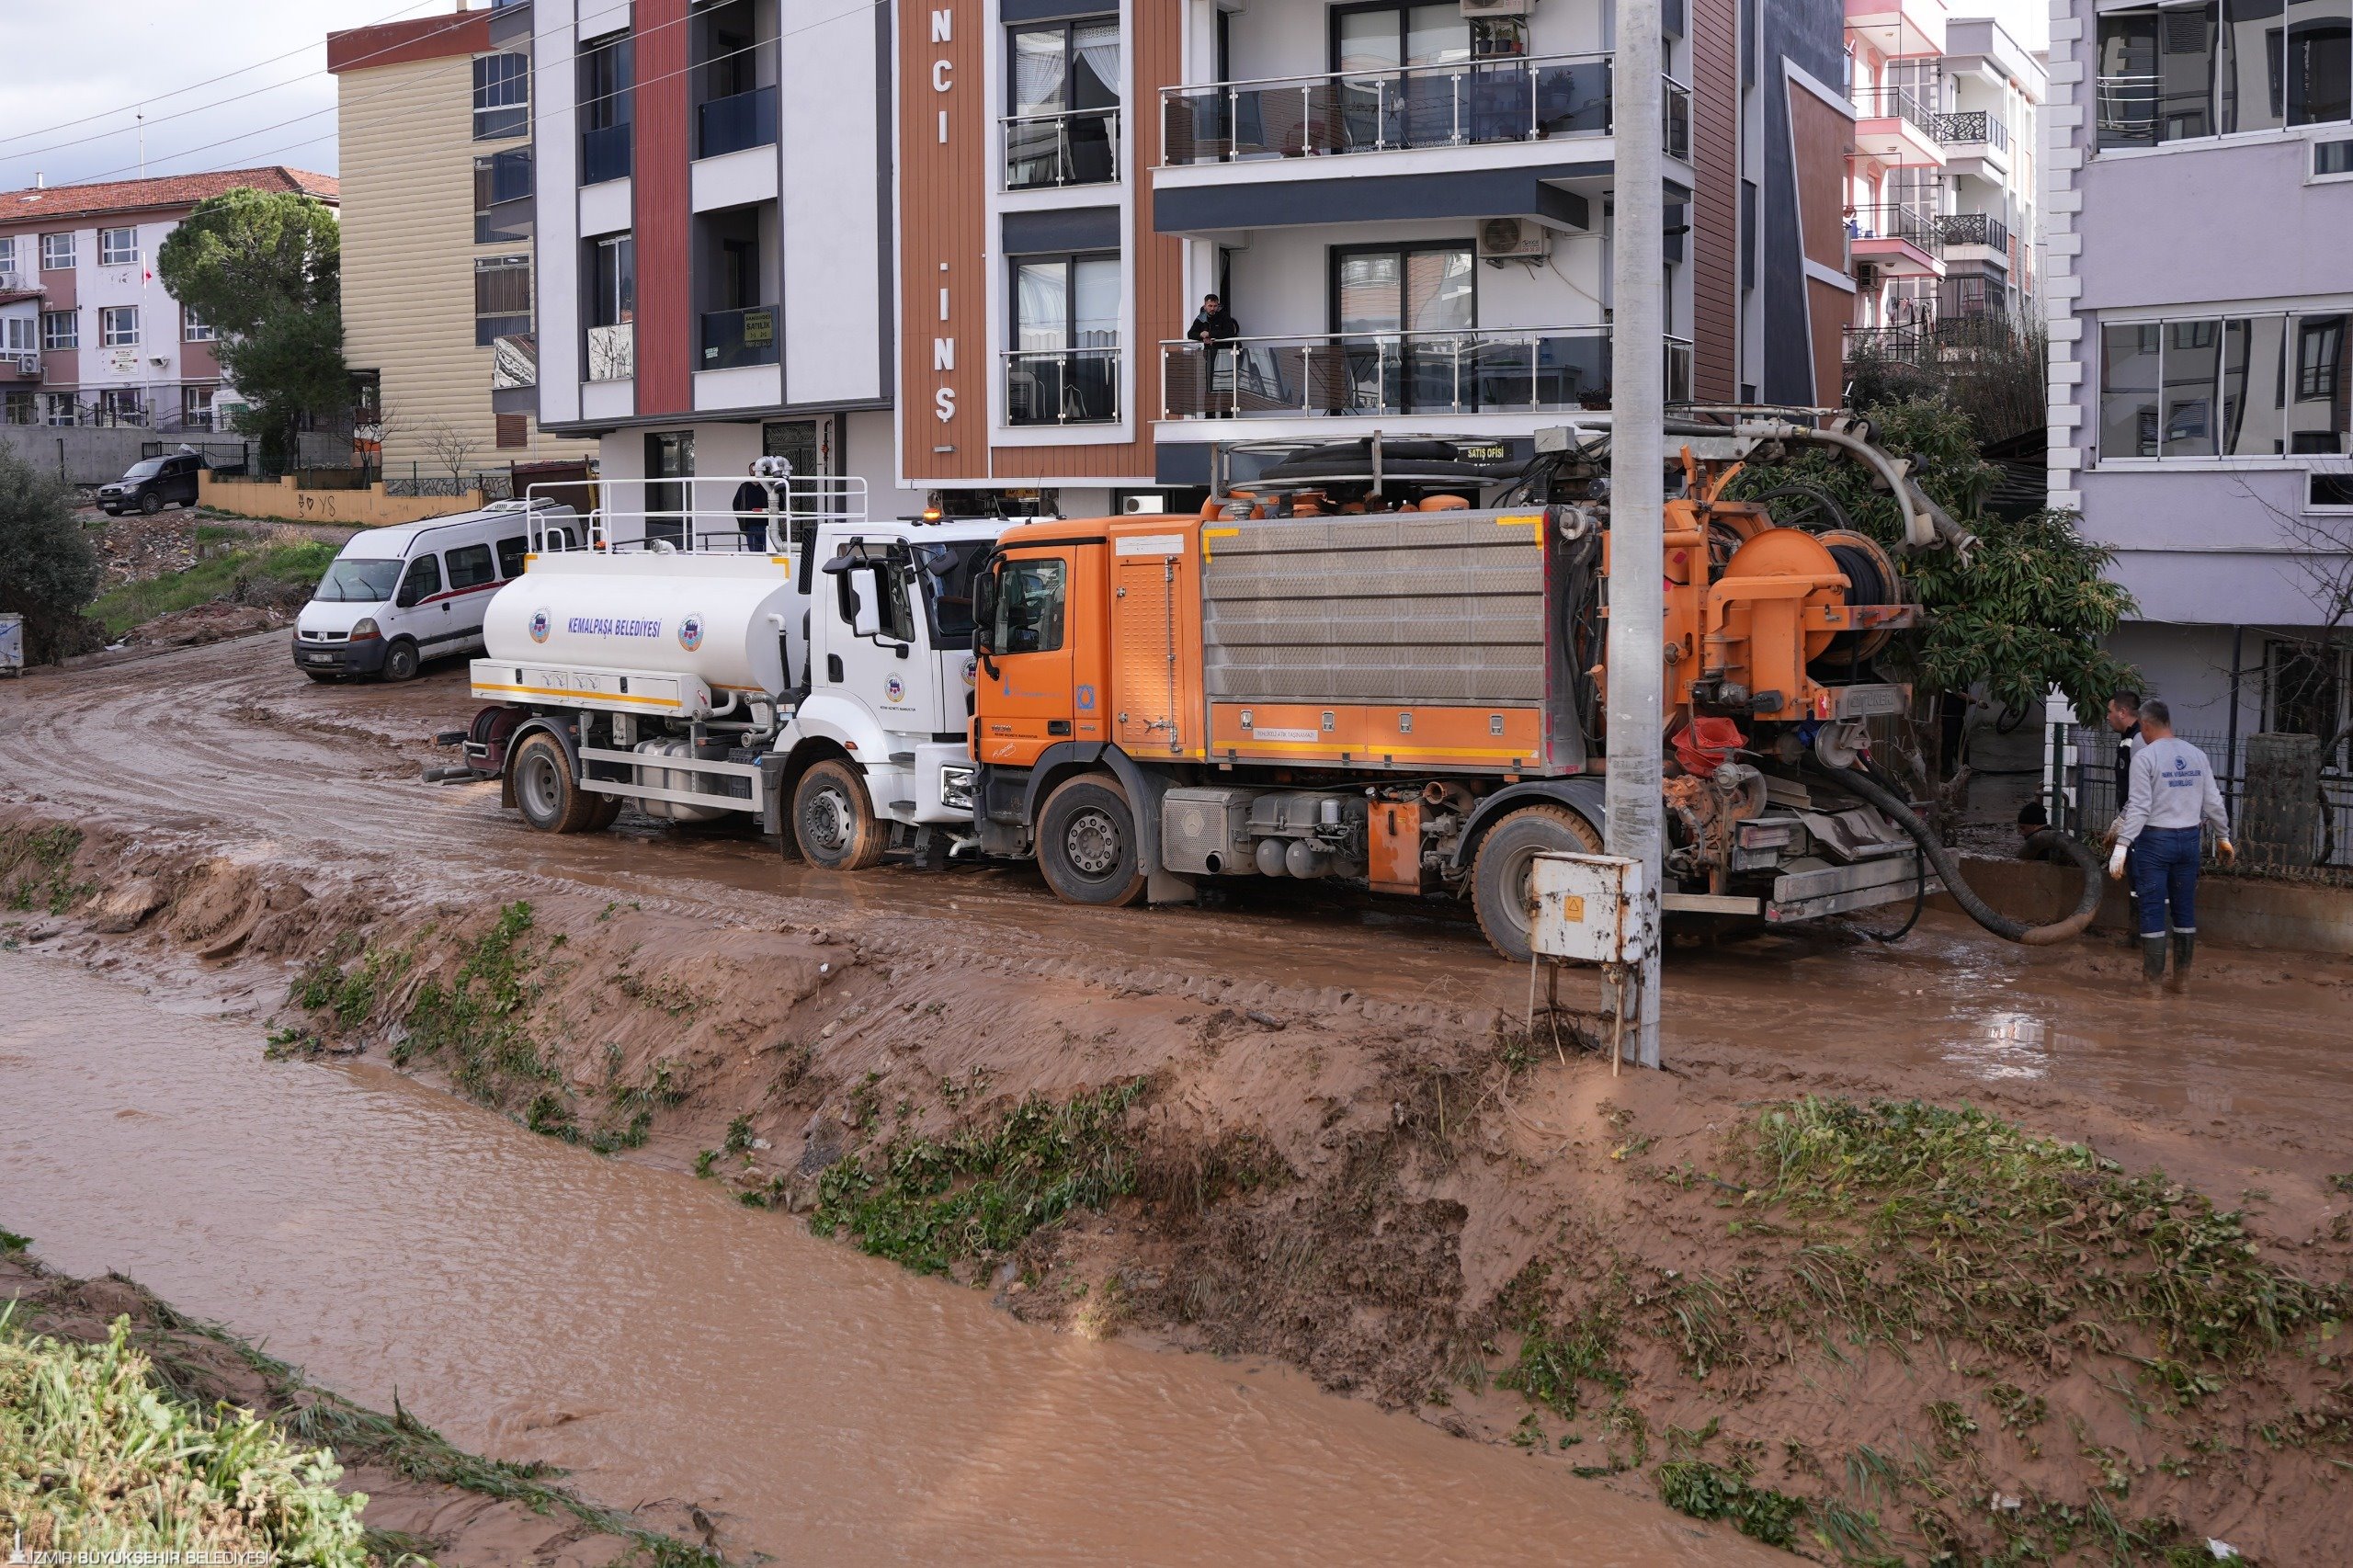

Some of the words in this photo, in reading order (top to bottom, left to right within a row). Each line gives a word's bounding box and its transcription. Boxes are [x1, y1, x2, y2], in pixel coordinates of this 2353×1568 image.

[1467, 448, 1486, 460] SATIŞ
[1486, 446, 1504, 459] OFİSİ
[568, 617, 613, 639] KEMALPAŞA
[615, 616, 663, 638] BELEDİYESİ
